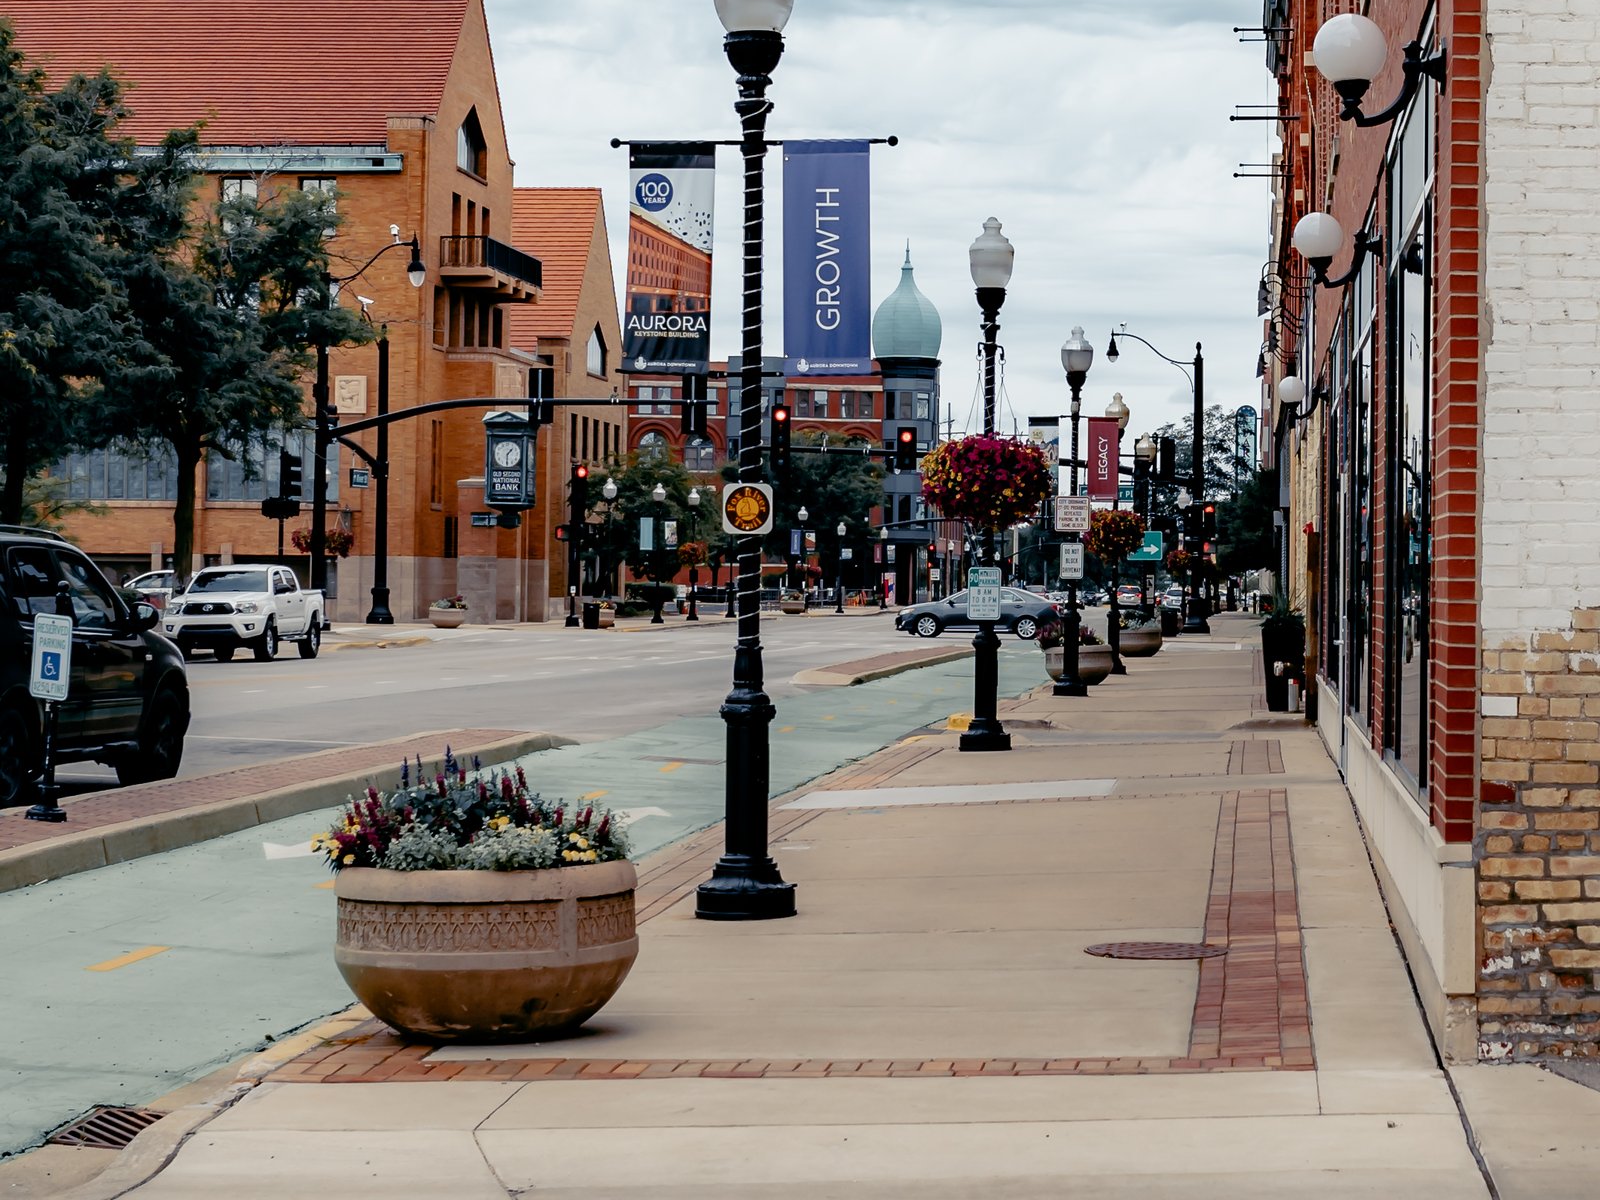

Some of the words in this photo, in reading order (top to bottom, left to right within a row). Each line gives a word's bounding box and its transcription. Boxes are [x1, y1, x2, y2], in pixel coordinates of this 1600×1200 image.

[639, 182, 670, 197] 100
[815, 188, 841, 330] GROWTH
[627, 315, 707, 331] AURORA
[1098, 436, 1108, 480] LEGACY
[495, 483, 519, 491] BANK
[727, 493, 742, 511] Fox
[745, 488, 766, 512] River
[735, 516, 763, 529] Trail
[970, 573, 979, 583] 90
[979, 570, 998, 578] MINUTE
[37, 623, 69, 635] RESERVED
[39, 637, 65, 649] PARKING
[51, 684, 65, 694] FINE
